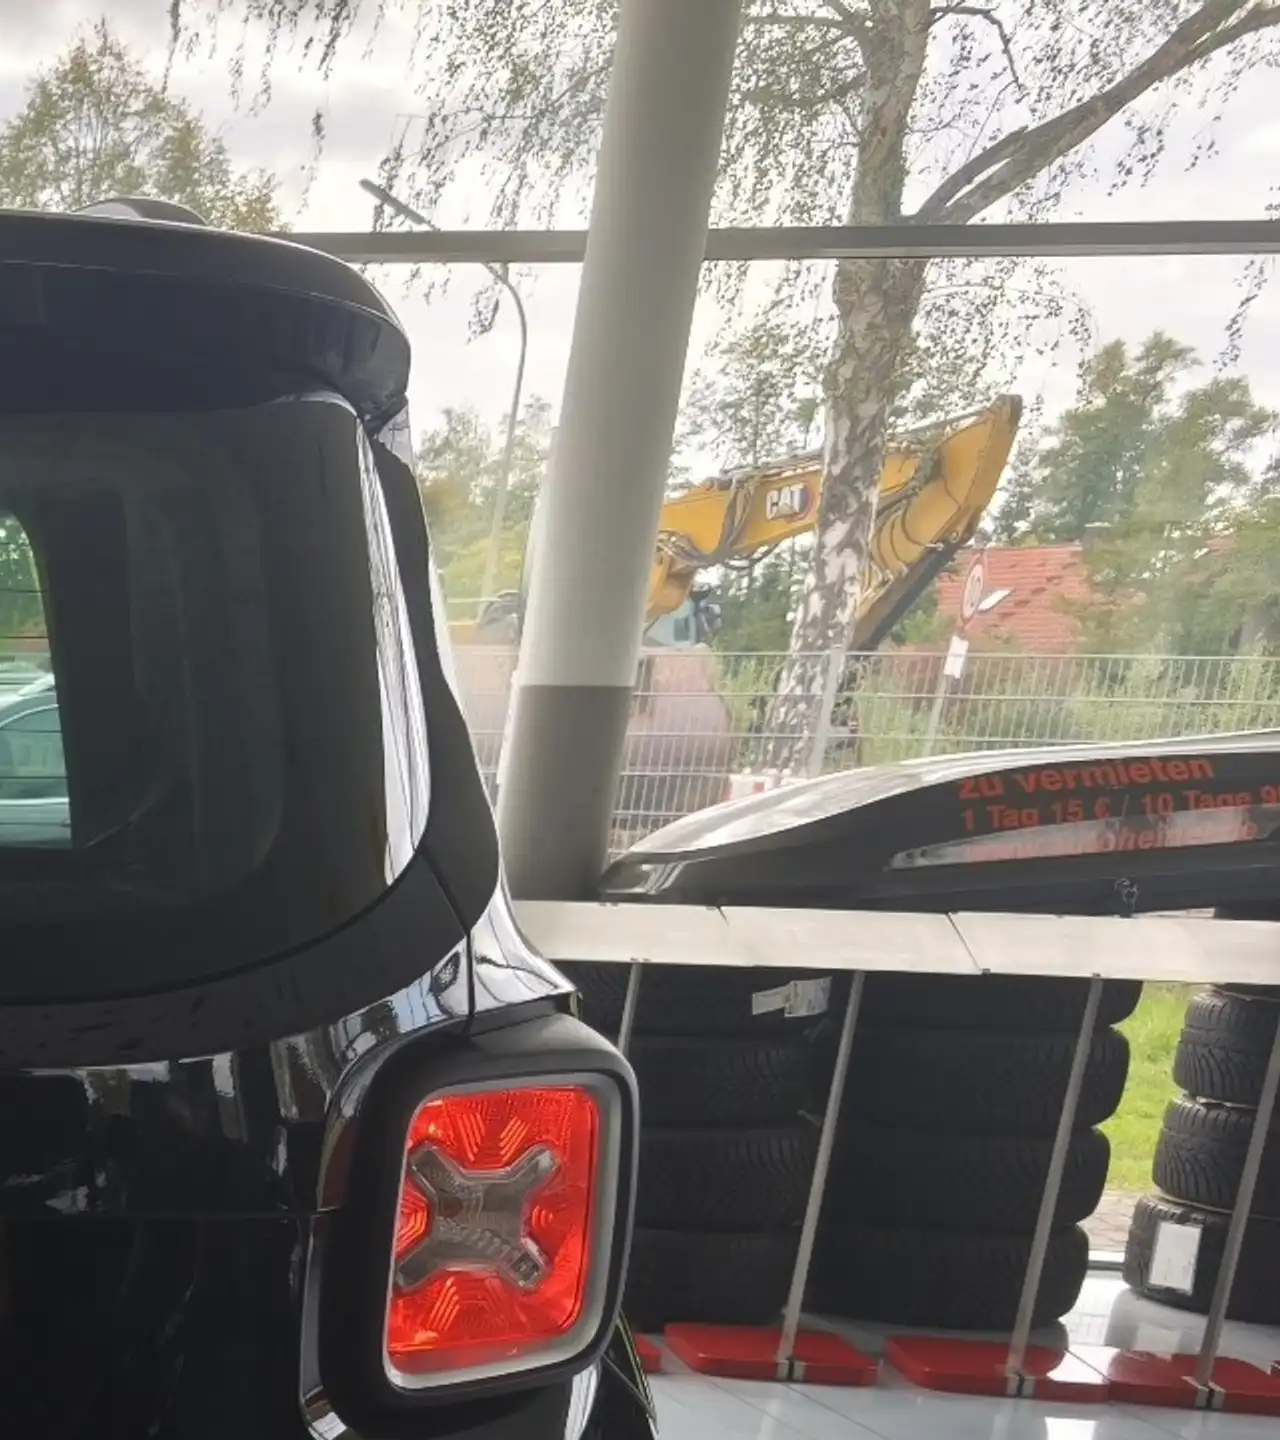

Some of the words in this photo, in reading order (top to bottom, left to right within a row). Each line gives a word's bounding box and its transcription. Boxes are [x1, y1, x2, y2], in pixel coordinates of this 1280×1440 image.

[766, 482, 804, 520] CAT
[957, 779, 1004, 801] zu
[1016, 757, 1213, 794] vermieten
[960, 809, 974, 831] 1
[987, 804, 1038, 830] Tag
[1051, 799, 1084, 824] 15
[1141, 793, 1171, 816] 10
